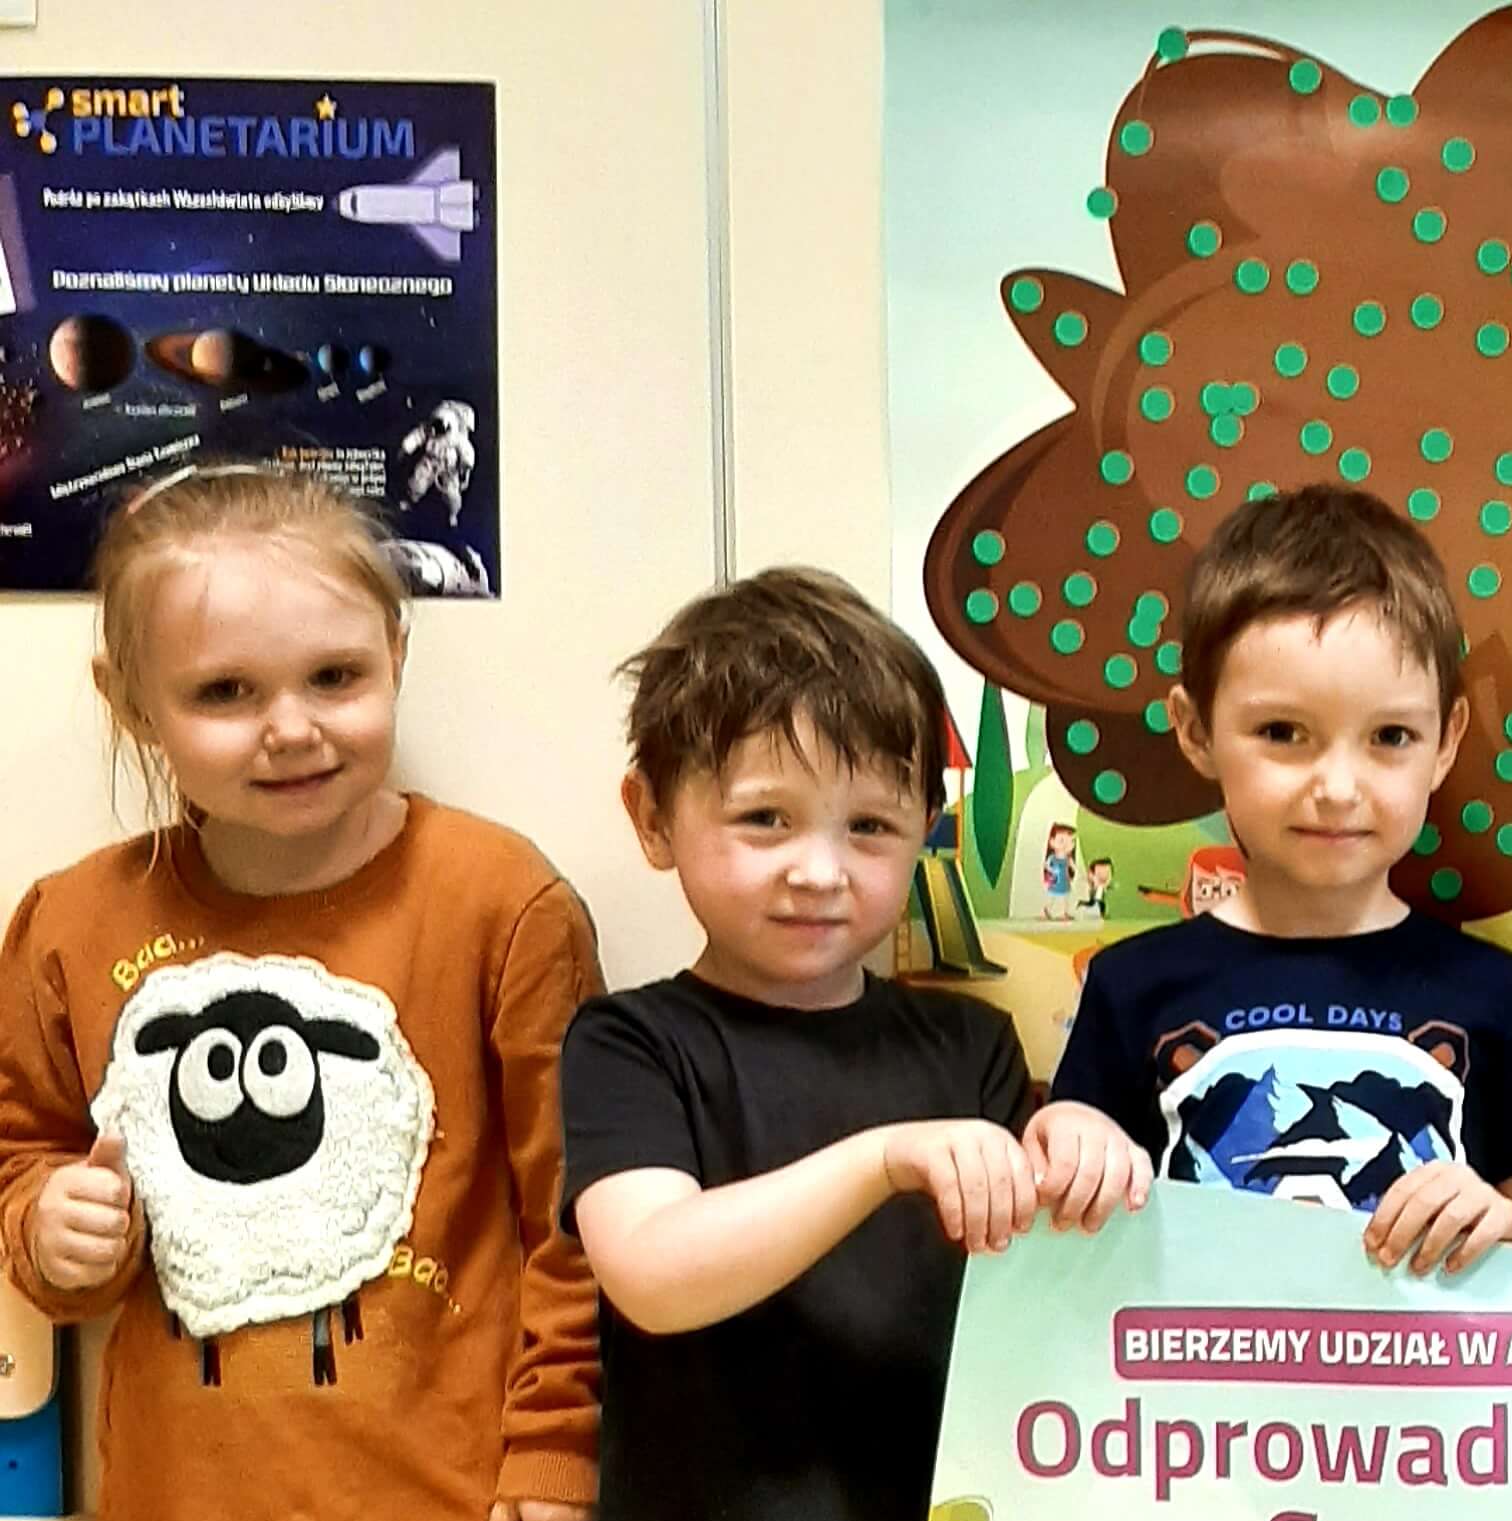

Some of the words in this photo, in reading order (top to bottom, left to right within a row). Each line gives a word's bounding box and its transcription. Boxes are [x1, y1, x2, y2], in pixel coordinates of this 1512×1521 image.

[70, 84, 185, 118] smart
[72, 114, 416, 159] PLANETARIUM
[86, 190, 102, 209] po
[52, 270, 168, 293] Poznaliśmy
[173, 272, 250, 295] planety
[253, 273, 320, 293] Układu
[323, 273, 453, 297] Słonecznego
[1225, 1003, 1314, 1031] COOL
[1327, 1004, 1404, 1033] DAYS
[1125, 1328, 1310, 1363] BIERZEMY
[1319, 1330, 1451, 1367] UDZIAŁ
[1457, 1331, 1498, 1367] W
